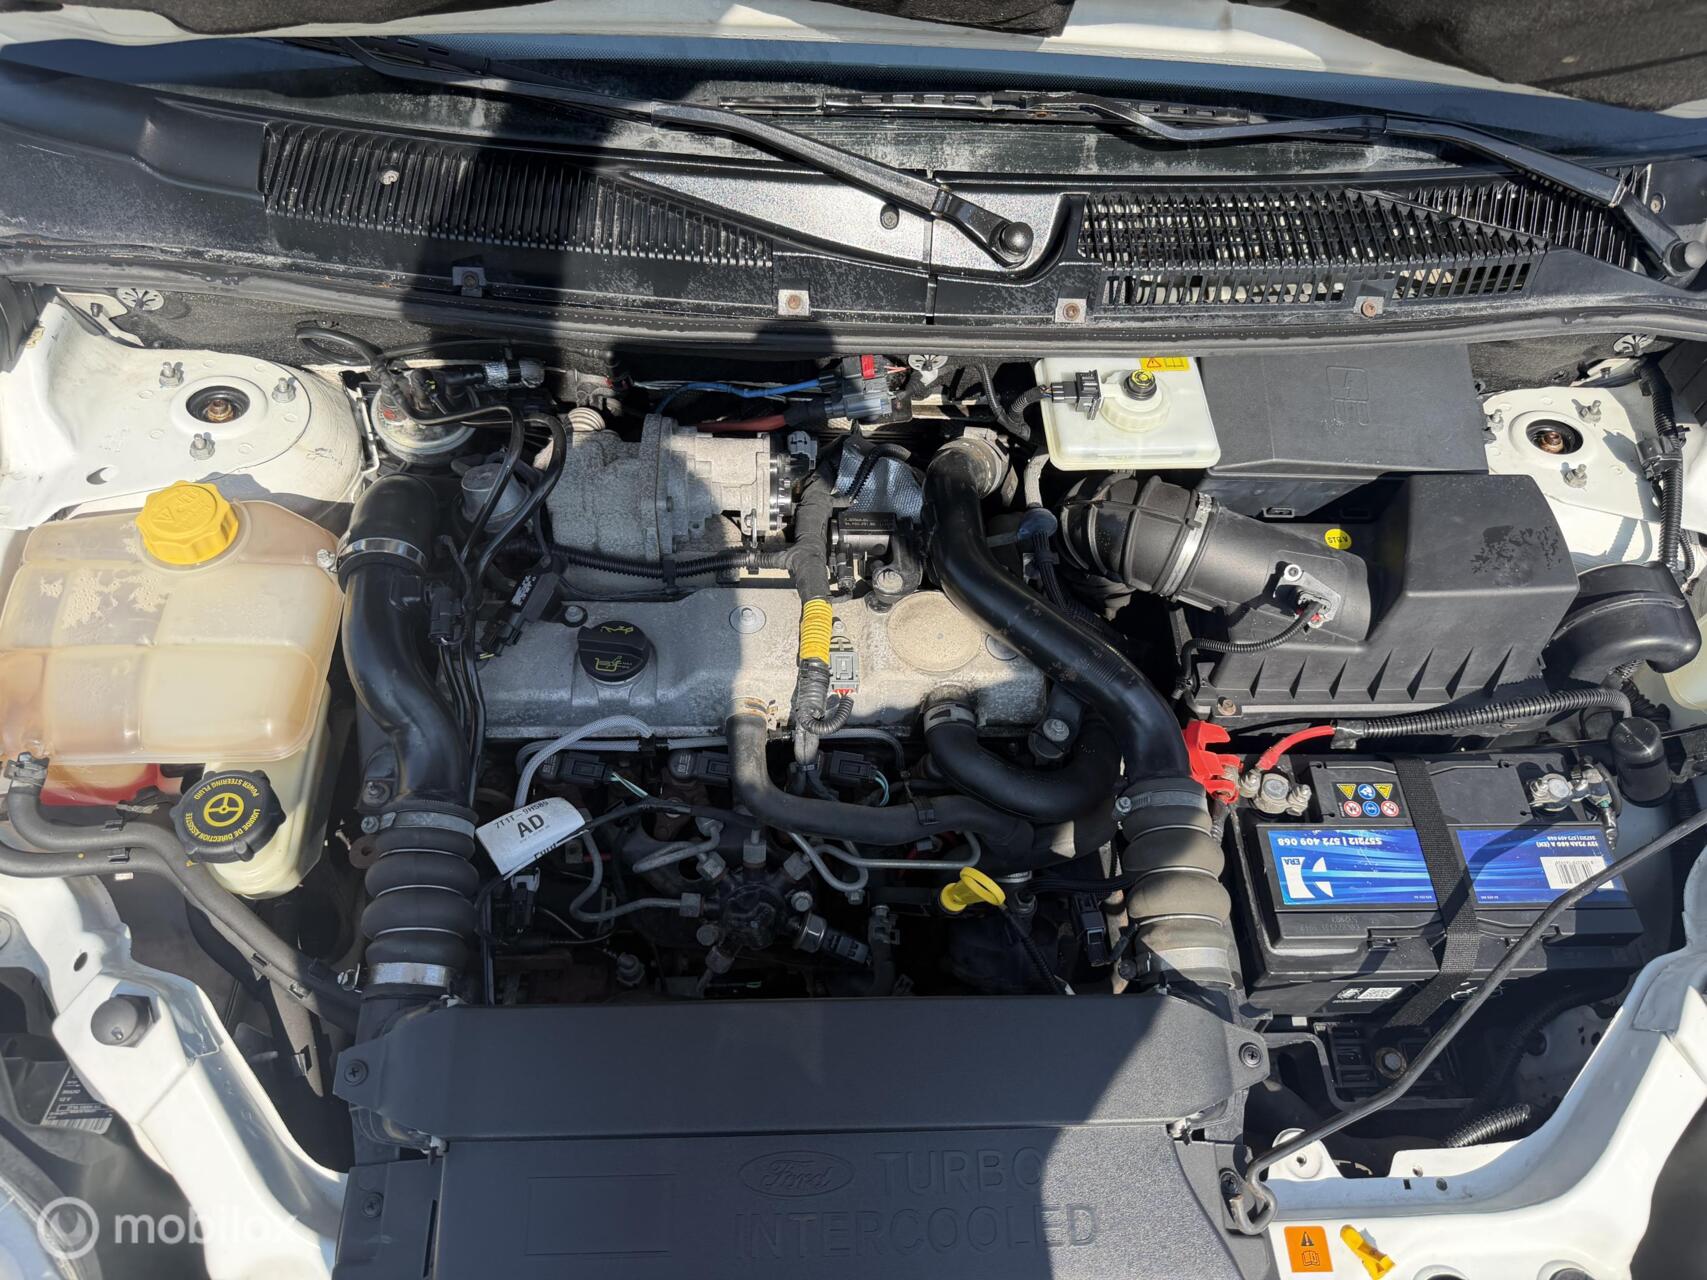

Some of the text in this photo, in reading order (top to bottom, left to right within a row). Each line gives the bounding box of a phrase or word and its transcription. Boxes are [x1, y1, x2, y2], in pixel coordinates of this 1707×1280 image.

[194, 777, 260, 800] POWER STEERING FLUID
[517, 814, 545, 838] AD
[198, 831, 234, 843] DIRECTION
[1277, 837, 1298, 846] 068
[1300, 837, 1319, 846] 409
[1322, 837, 1341, 846] 572
[1283, 858, 1301, 866] ERA
[761, 1146, 1044, 1196] Ford TURBO
[735, 1203, 1098, 1258] INTERCOOLED
